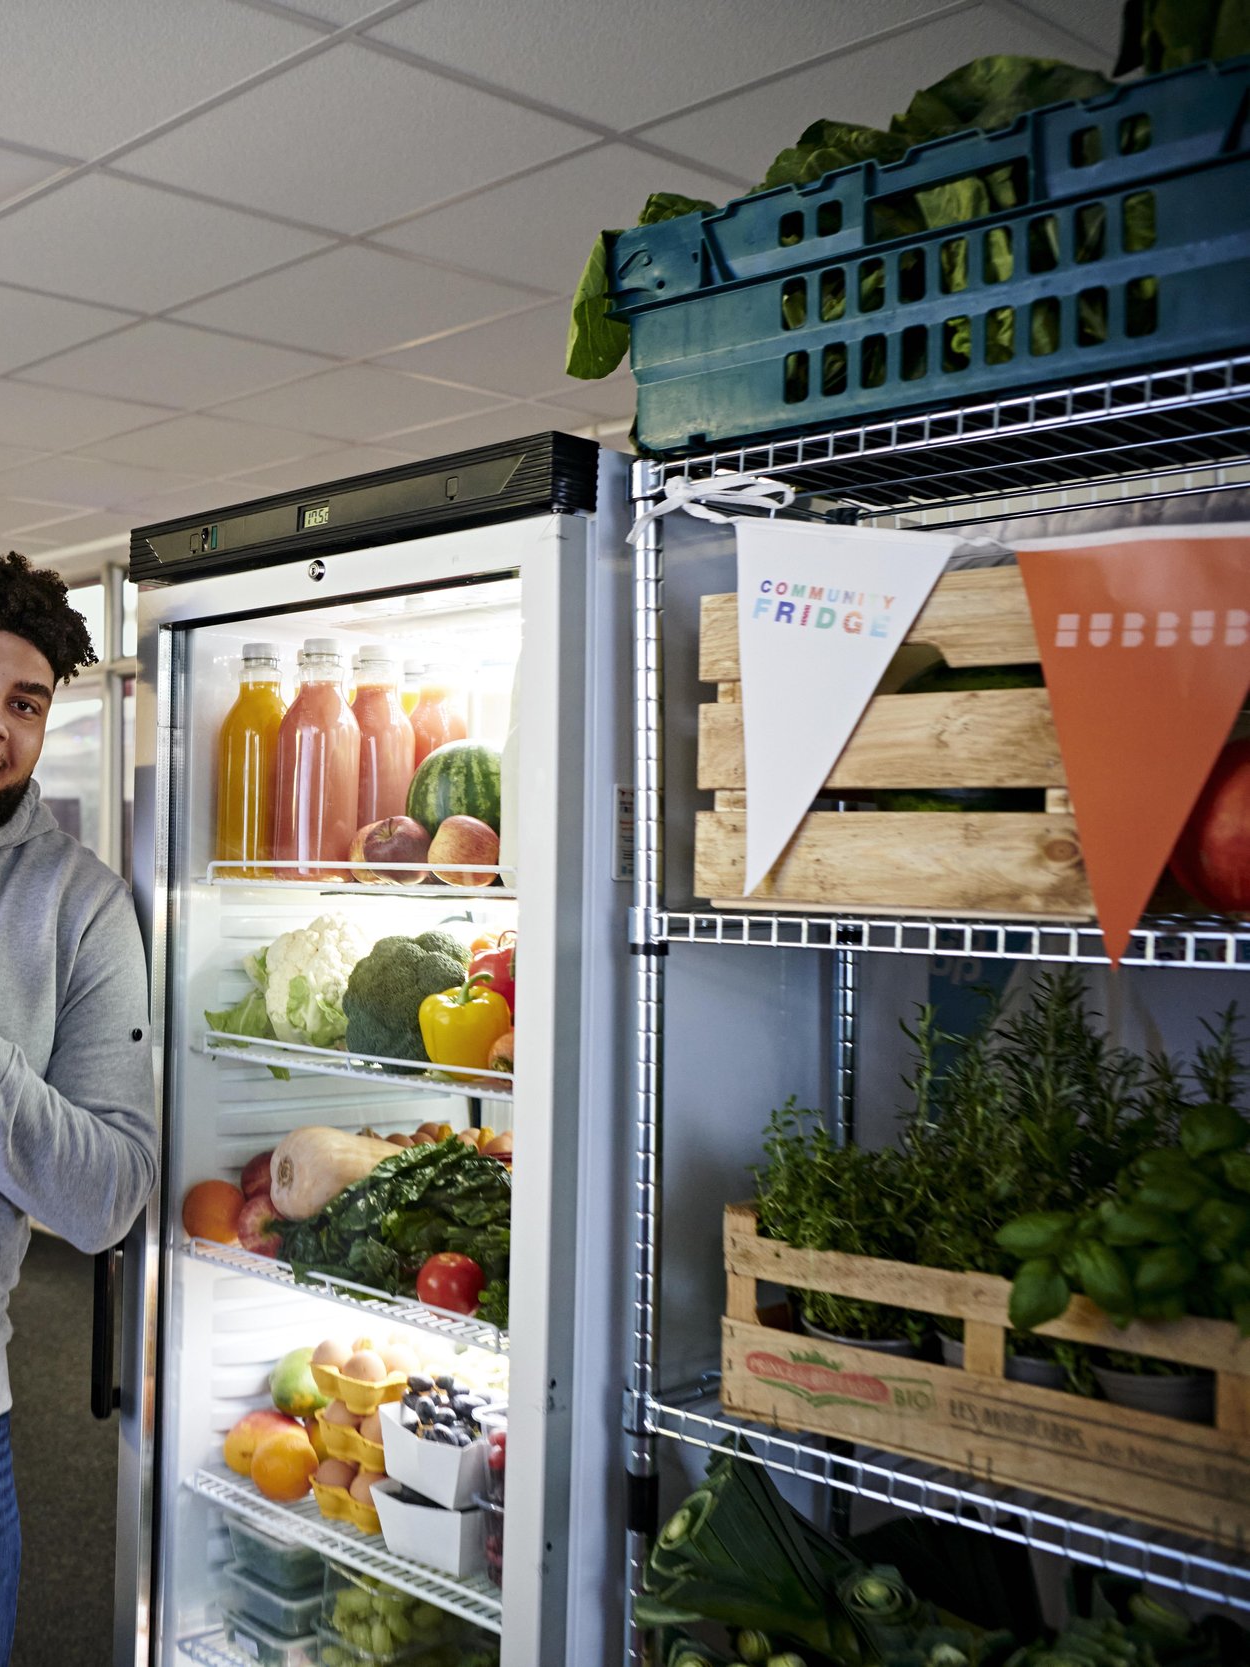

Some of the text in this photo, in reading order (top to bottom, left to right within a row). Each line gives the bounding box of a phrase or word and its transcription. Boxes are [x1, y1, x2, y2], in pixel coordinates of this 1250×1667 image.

[760, 580, 895, 609] COMMUNITY
[752, 598, 892, 638] FRIDGE
[892, 1386, 931, 1411] BIO
